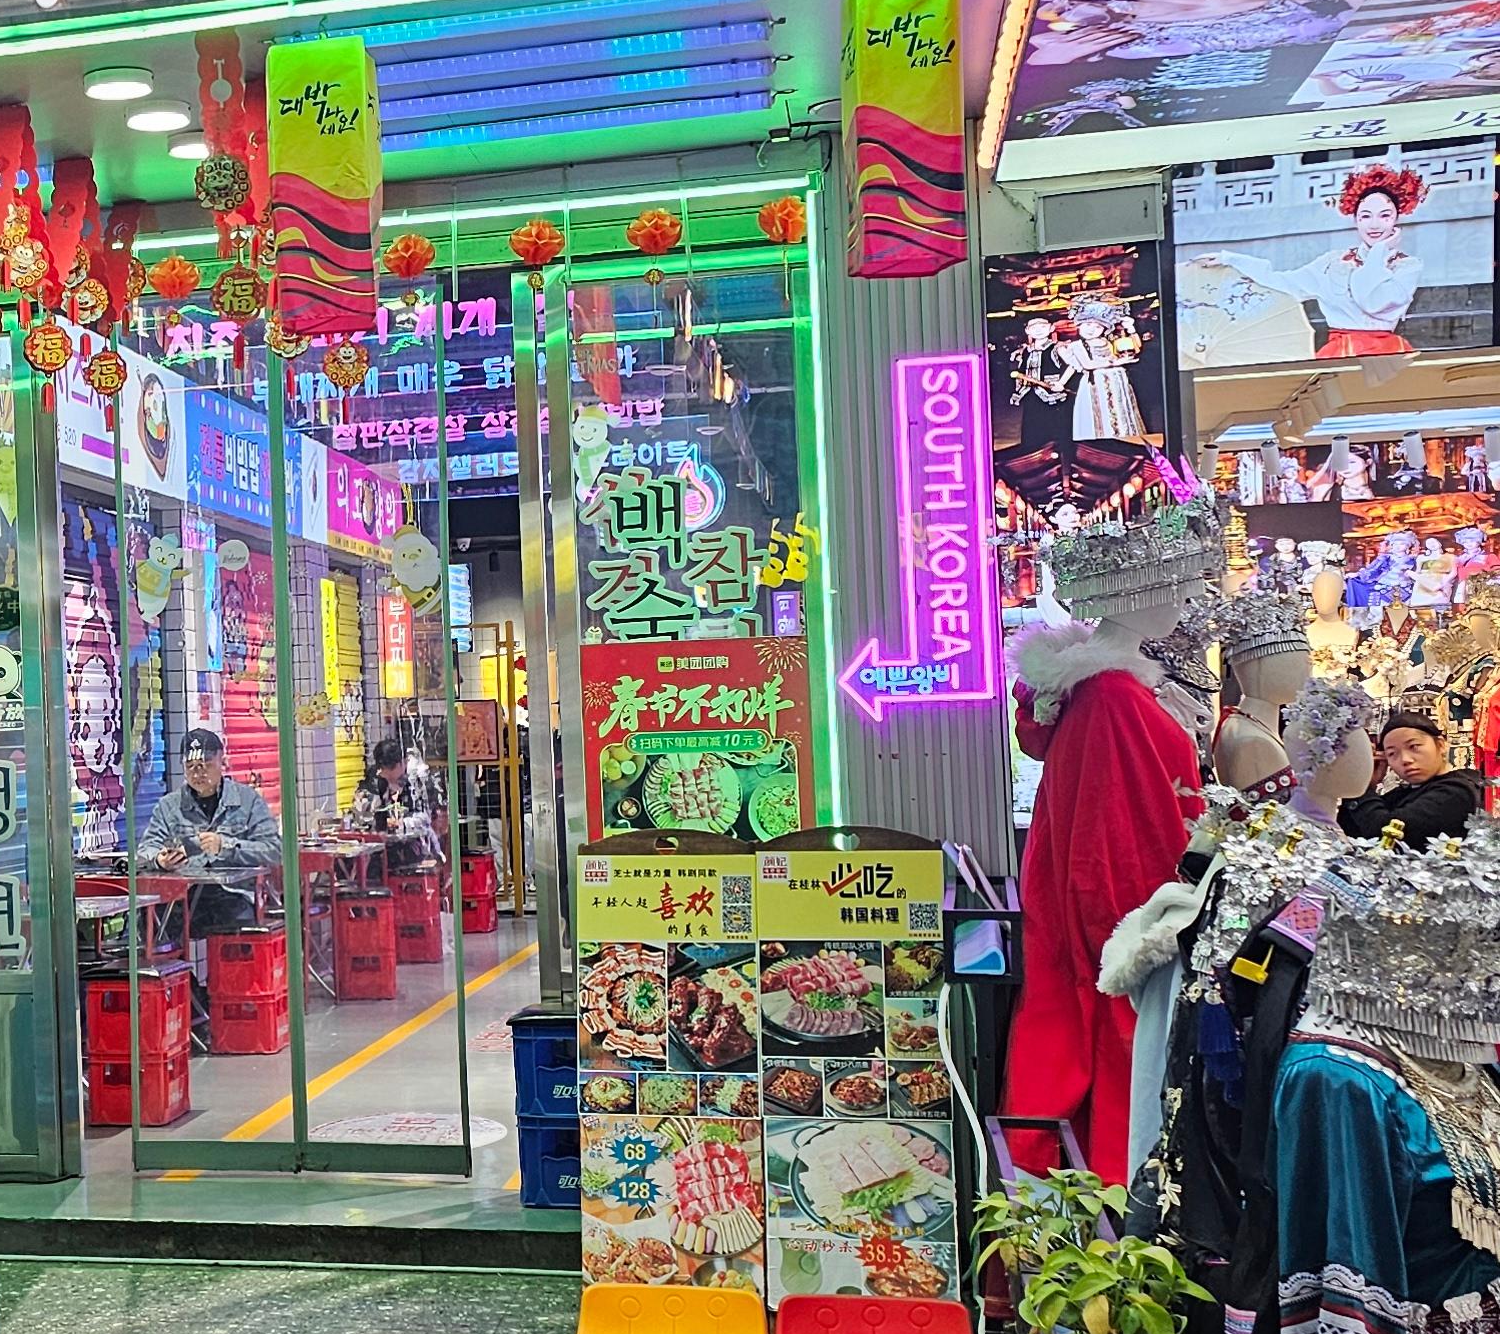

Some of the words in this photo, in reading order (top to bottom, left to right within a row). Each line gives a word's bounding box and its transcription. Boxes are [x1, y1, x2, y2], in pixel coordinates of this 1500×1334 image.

[920, 366, 968, 512] SOUTH
[928, 523, 972, 661] KOREA
[598, 674, 795, 737] 春节不打烊
[831, 862, 895, 899] 必吃
[650, 881, 715, 921] 喜欢
[840, 906, 900, 925] 韩国料理
[623, 1143, 647, 1161] 68
[557, 1174, 583, 1188] 可口
[618, 1181, 650, 1199] 128
[864, 1243, 902, 1264] 38.5
